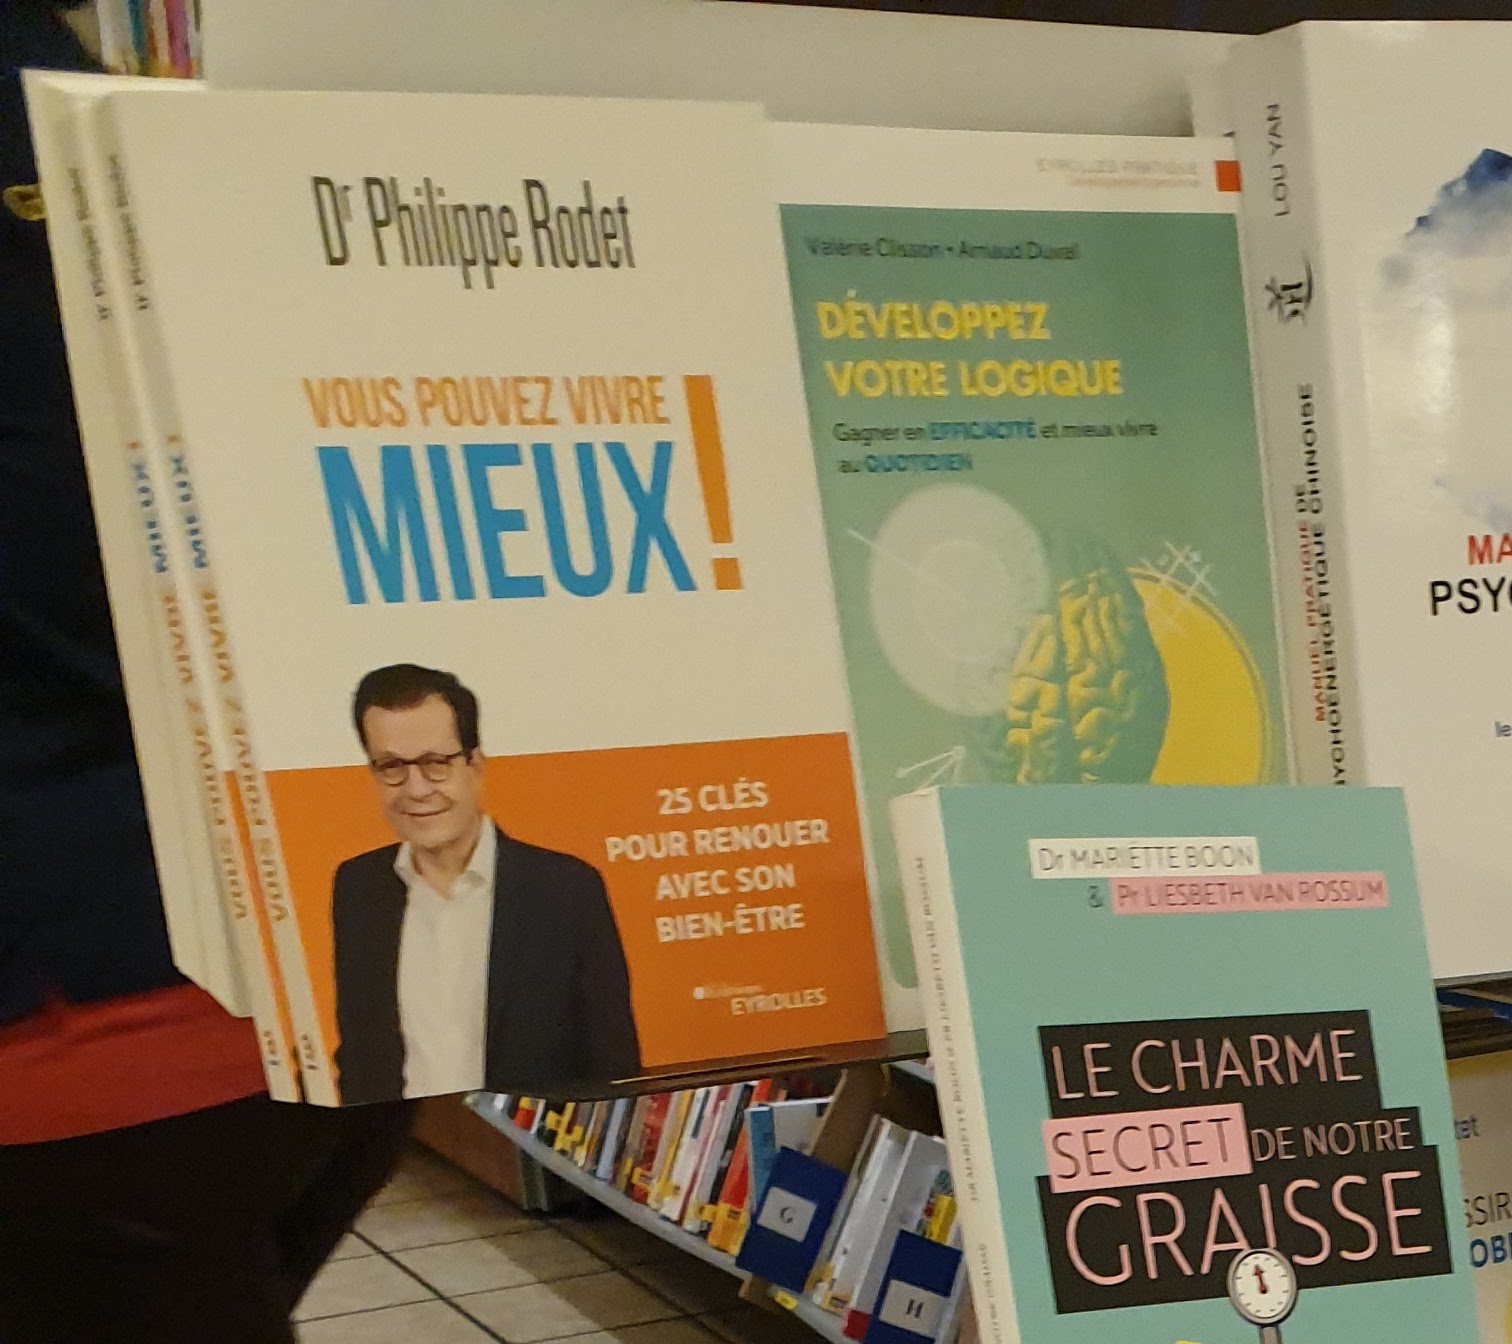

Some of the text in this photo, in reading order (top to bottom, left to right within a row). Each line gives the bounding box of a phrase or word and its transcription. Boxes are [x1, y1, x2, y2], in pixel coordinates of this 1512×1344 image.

[310, 176, 636, 289] Dr Philippe Rodet
[815, 290, 1051, 339] DÉVELOPPEZ
[823, 360, 1124, 396] VOTRE LOGIQUE
[302, 375, 670, 428] VOUS POUVEZ VIVRE
[1494, 720, 1511, 738] le
[656, 777, 768, 816] 25 CLÉS
[605, 819, 829, 862] POUR RENOUER
[1037, 845, 1254, 871] Dr MARIETTE BOON
[654, 862, 795, 901] AVEC SON
[1249, 882, 1295, 903] VAN
[655, 902, 805, 942] BIEN-ÊTRE
[731, 986, 827, 1017] EYROLLES
[1051, 1028, 1363, 1101] LE CHARME
[1050, 1117, 1415, 1181] SECRET DE NOTRE
[1065, 1170, 1433, 1286] GRAISSE
